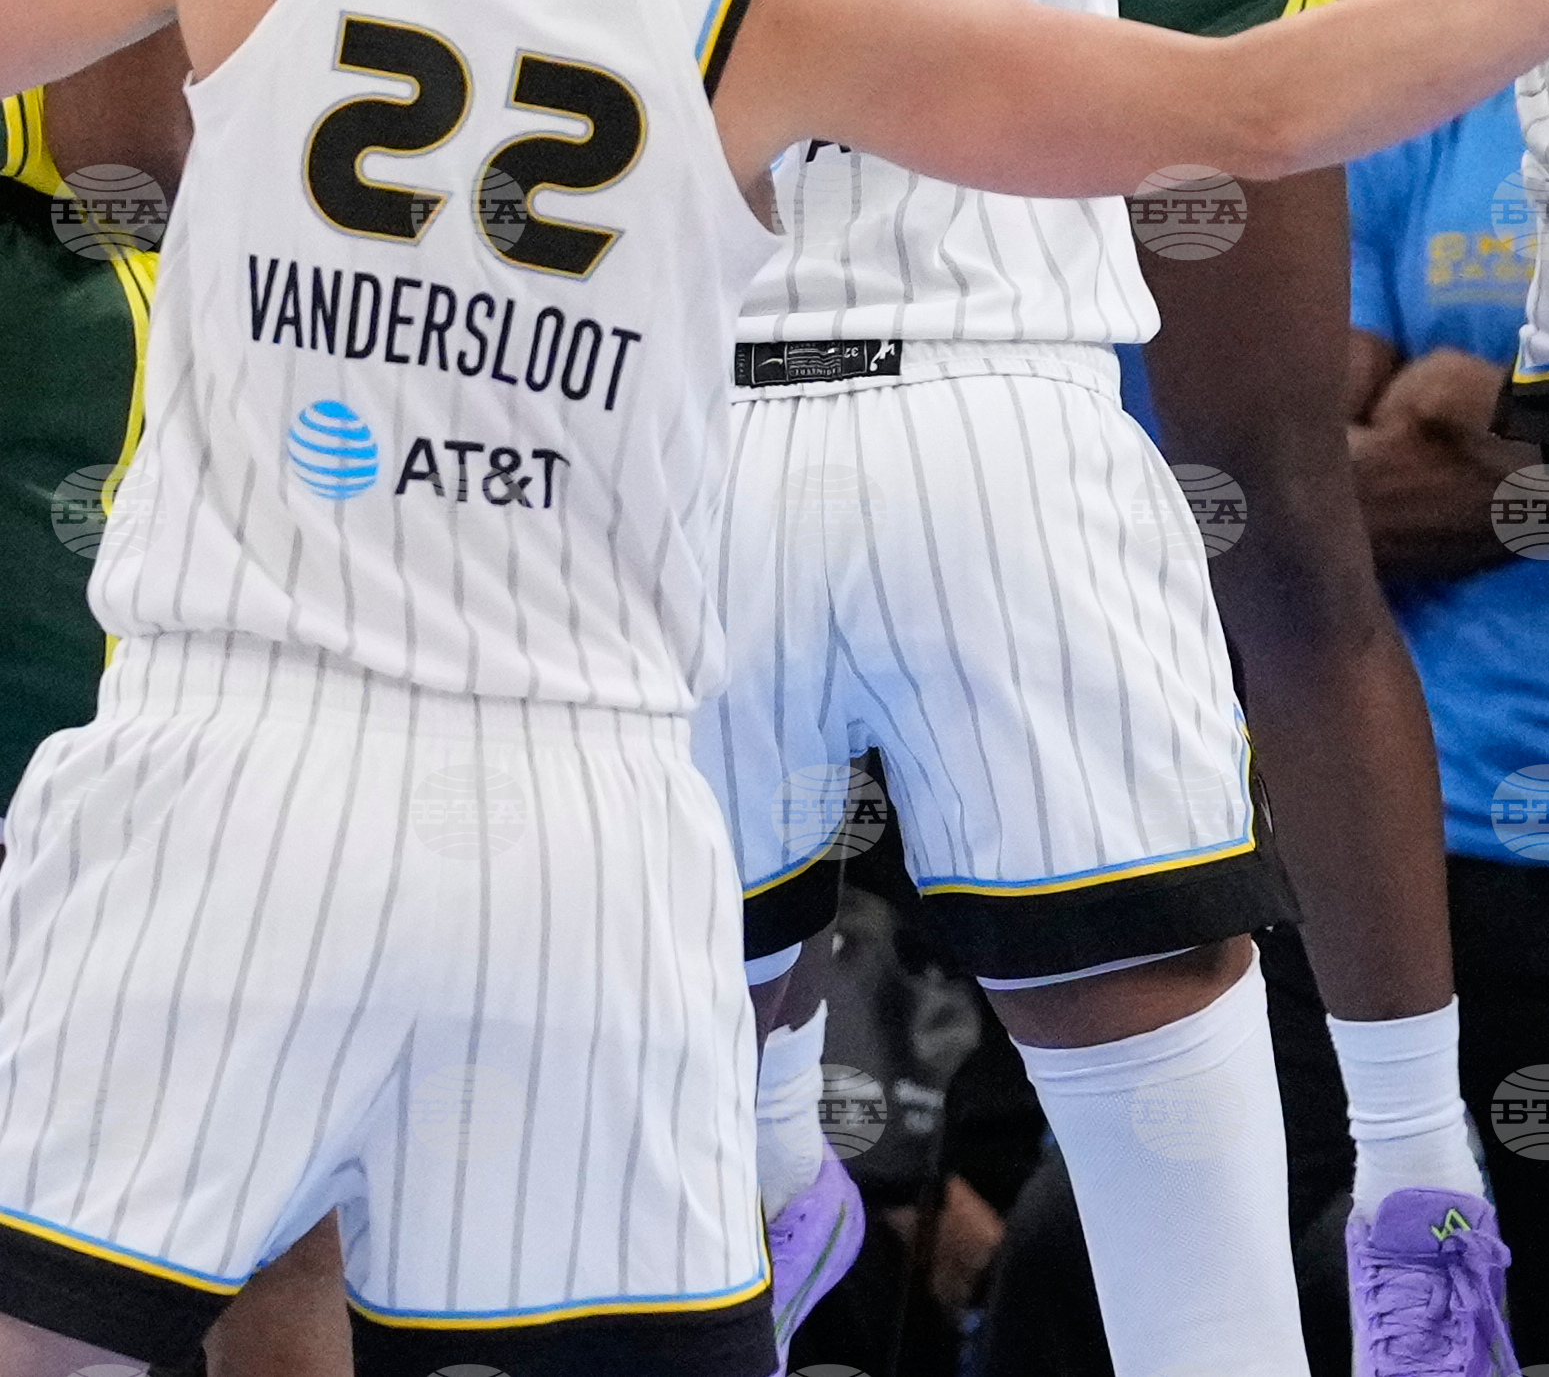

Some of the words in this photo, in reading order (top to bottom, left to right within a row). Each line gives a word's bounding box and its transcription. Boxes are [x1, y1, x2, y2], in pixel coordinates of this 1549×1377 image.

[301, 10, 648, 282] 22
[249, 255, 643, 412] VANDERSLOOT
[395, 437, 571, 509] AT&T
